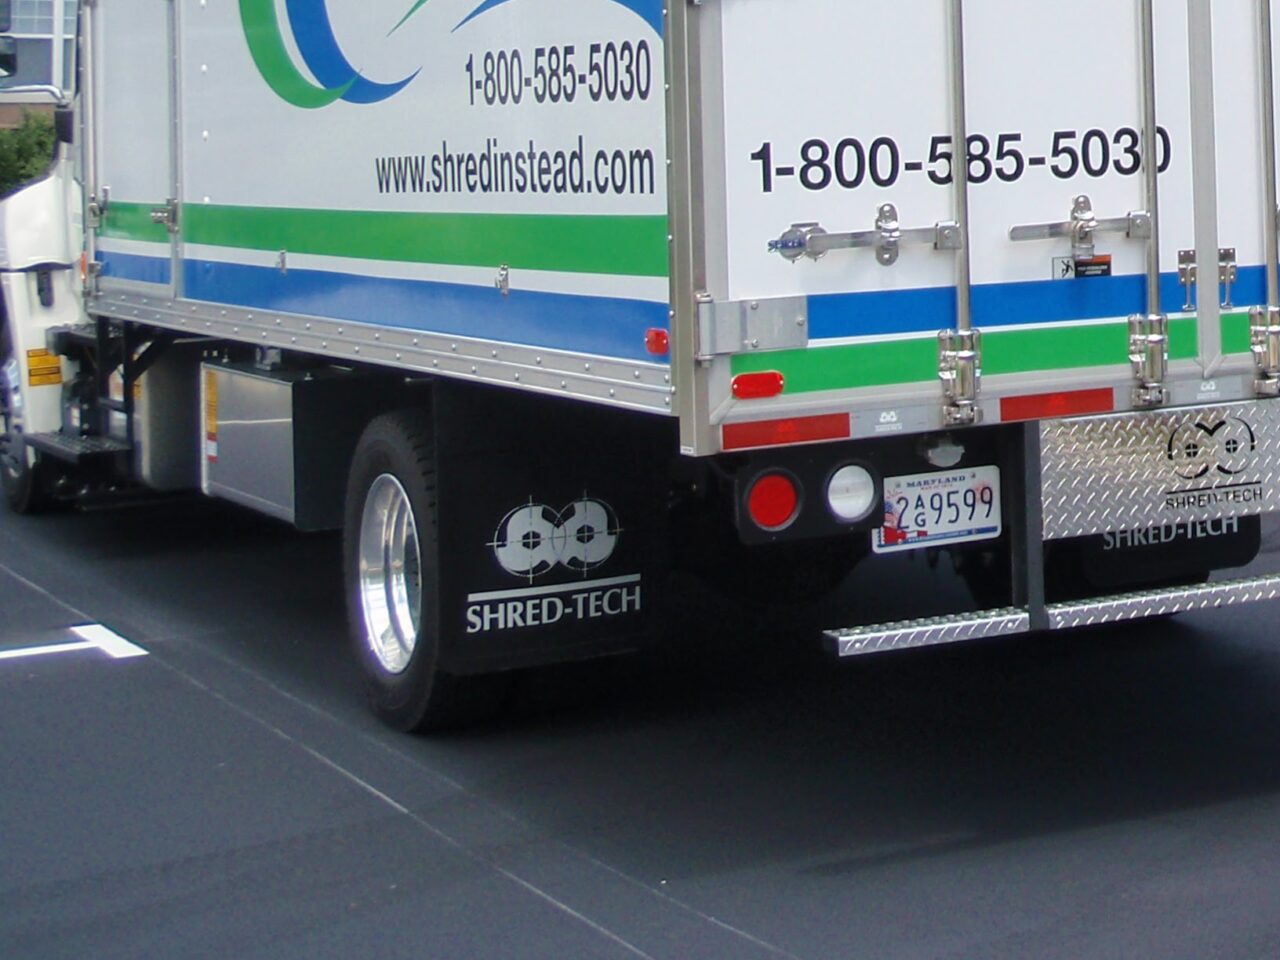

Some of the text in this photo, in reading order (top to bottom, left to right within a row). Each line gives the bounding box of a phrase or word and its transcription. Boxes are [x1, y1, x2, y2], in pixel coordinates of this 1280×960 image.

[464, 39, 652, 106] 1-800-585-5030
[375, 134, 655, 194] www.shredinstead.com
[749, 125, 1172, 193] 1-800-585-5030
[906, 474, 967, 489] MARYLAND
[465, 585, 642, 633] SHRED-TECH
